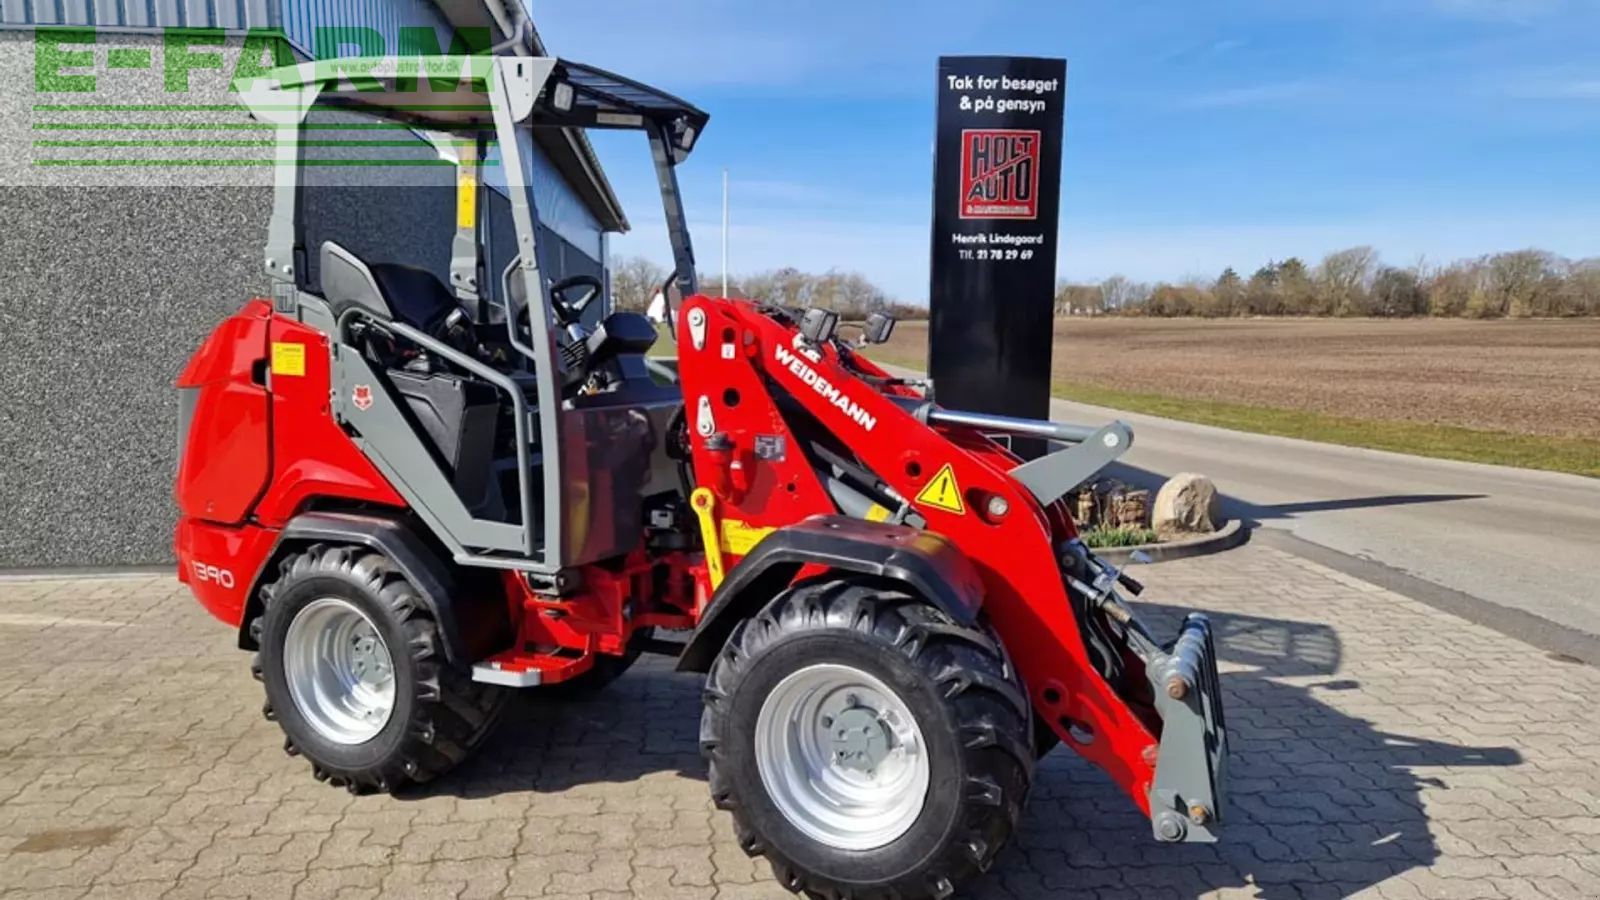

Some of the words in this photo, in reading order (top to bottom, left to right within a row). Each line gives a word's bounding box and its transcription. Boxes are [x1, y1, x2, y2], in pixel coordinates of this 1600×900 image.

[947, 75, 974, 90] Tak
[977, 75, 998, 90] for
[1002, 75, 1059, 94] besøget
[959, 96, 972, 110] &
[974, 96, 994, 113] på
[996, 99, 1046, 114] gensyn
[971, 135, 1034, 180] HOLT
[968, 156, 1033, 201] AUTO
[951, 233, 987, 244] Henrik
[989, 233, 1044, 246] Lindegaard
[1005, 249, 1018, 260] 29
[1020, 249, 1034, 260] 69
[774, 344, 877, 432] WEIDEMANN
[191, 559, 235, 589] 1390
